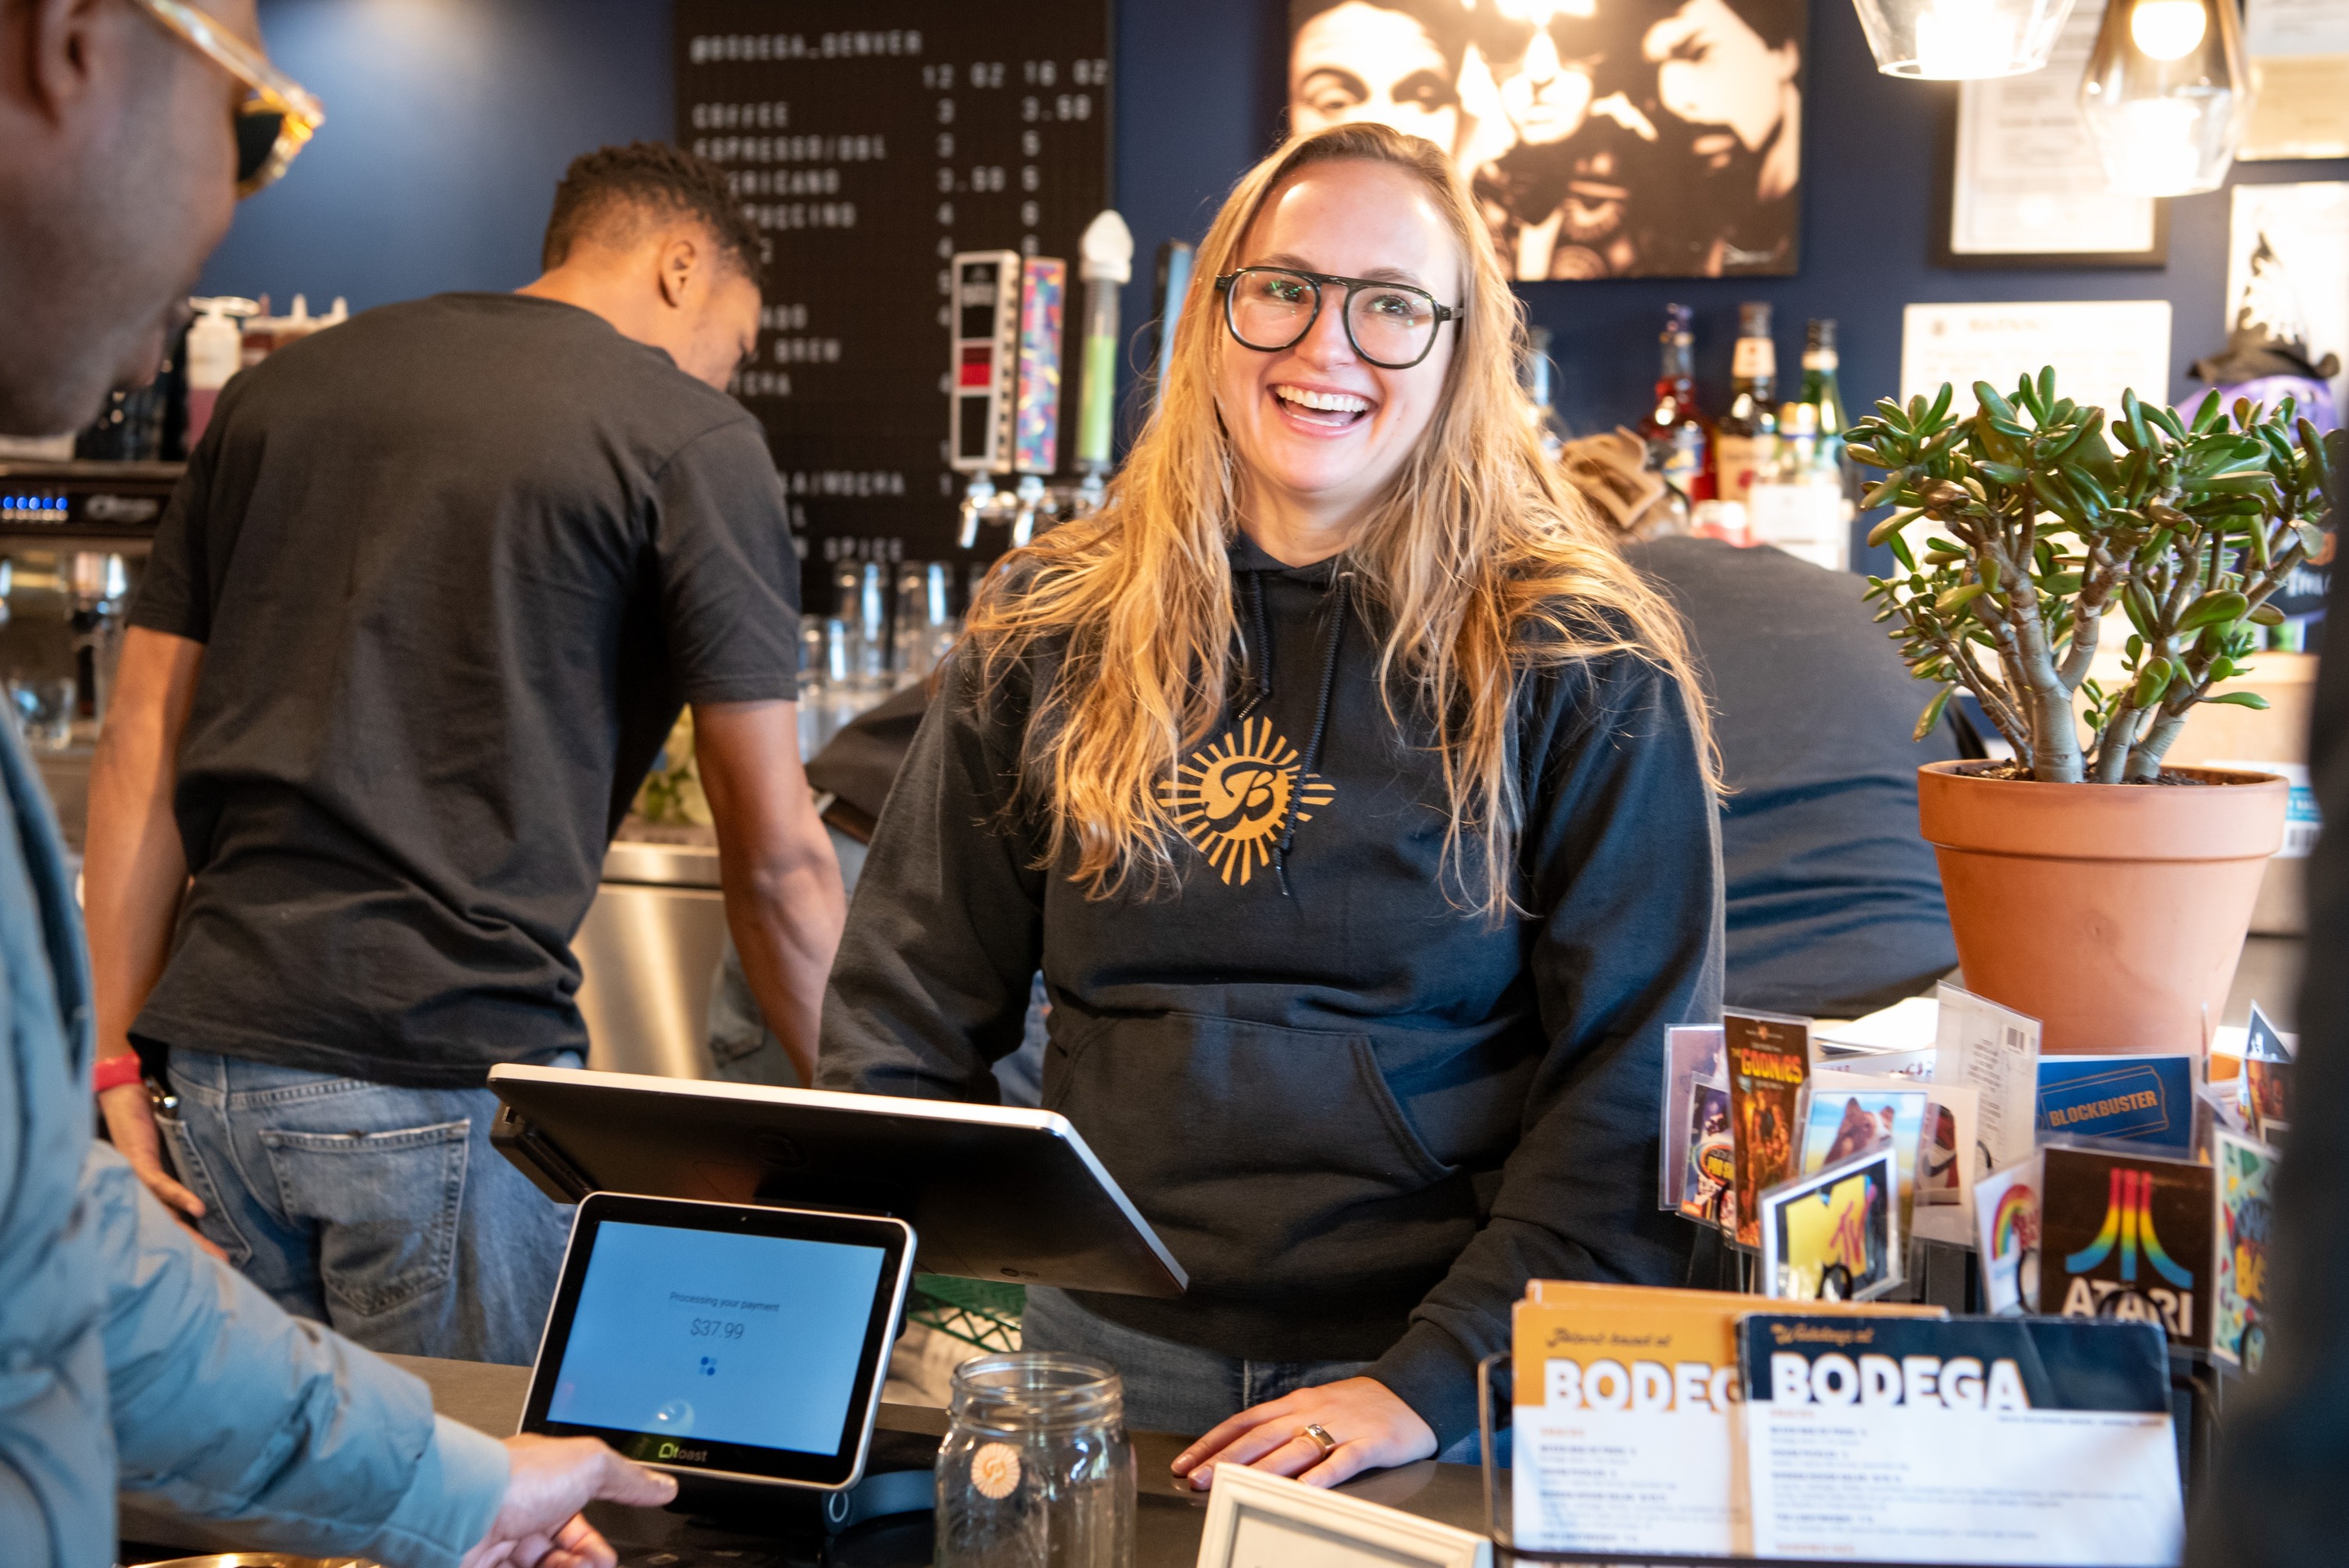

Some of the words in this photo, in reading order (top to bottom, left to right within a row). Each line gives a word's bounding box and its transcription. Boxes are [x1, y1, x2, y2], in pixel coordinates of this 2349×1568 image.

[922, 63, 954, 90] 12
[970, 61, 1006, 89] OZ
[1023, 59, 1056, 88] 16
[1073, 58, 1110, 86] OZ
[692, 101, 788, 130] COFFEE
[1021, 93, 1092, 122] 3.50
[728, 168, 840, 197] ERICANO
[937, 165, 1005, 193] 3.50
[1203, 760, 1282, 834] B
[1741, 1047, 1803, 1084] GOONIES
[2048, 1090, 2159, 1127] BLOCKBUSTER
[1785, 1173, 1878, 1298] MTV
[669, 1292, 718, 1307] Processing
[720, 1299, 739, 1308] your
[740, 1300, 780, 1312] payment
[2062, 1276, 2192, 1337] ATARI
[690, 1317, 745, 1339] $37.99
[1771, 1352, 2031, 1411] BODEGA
[673, 1446, 708, 1462] toast
